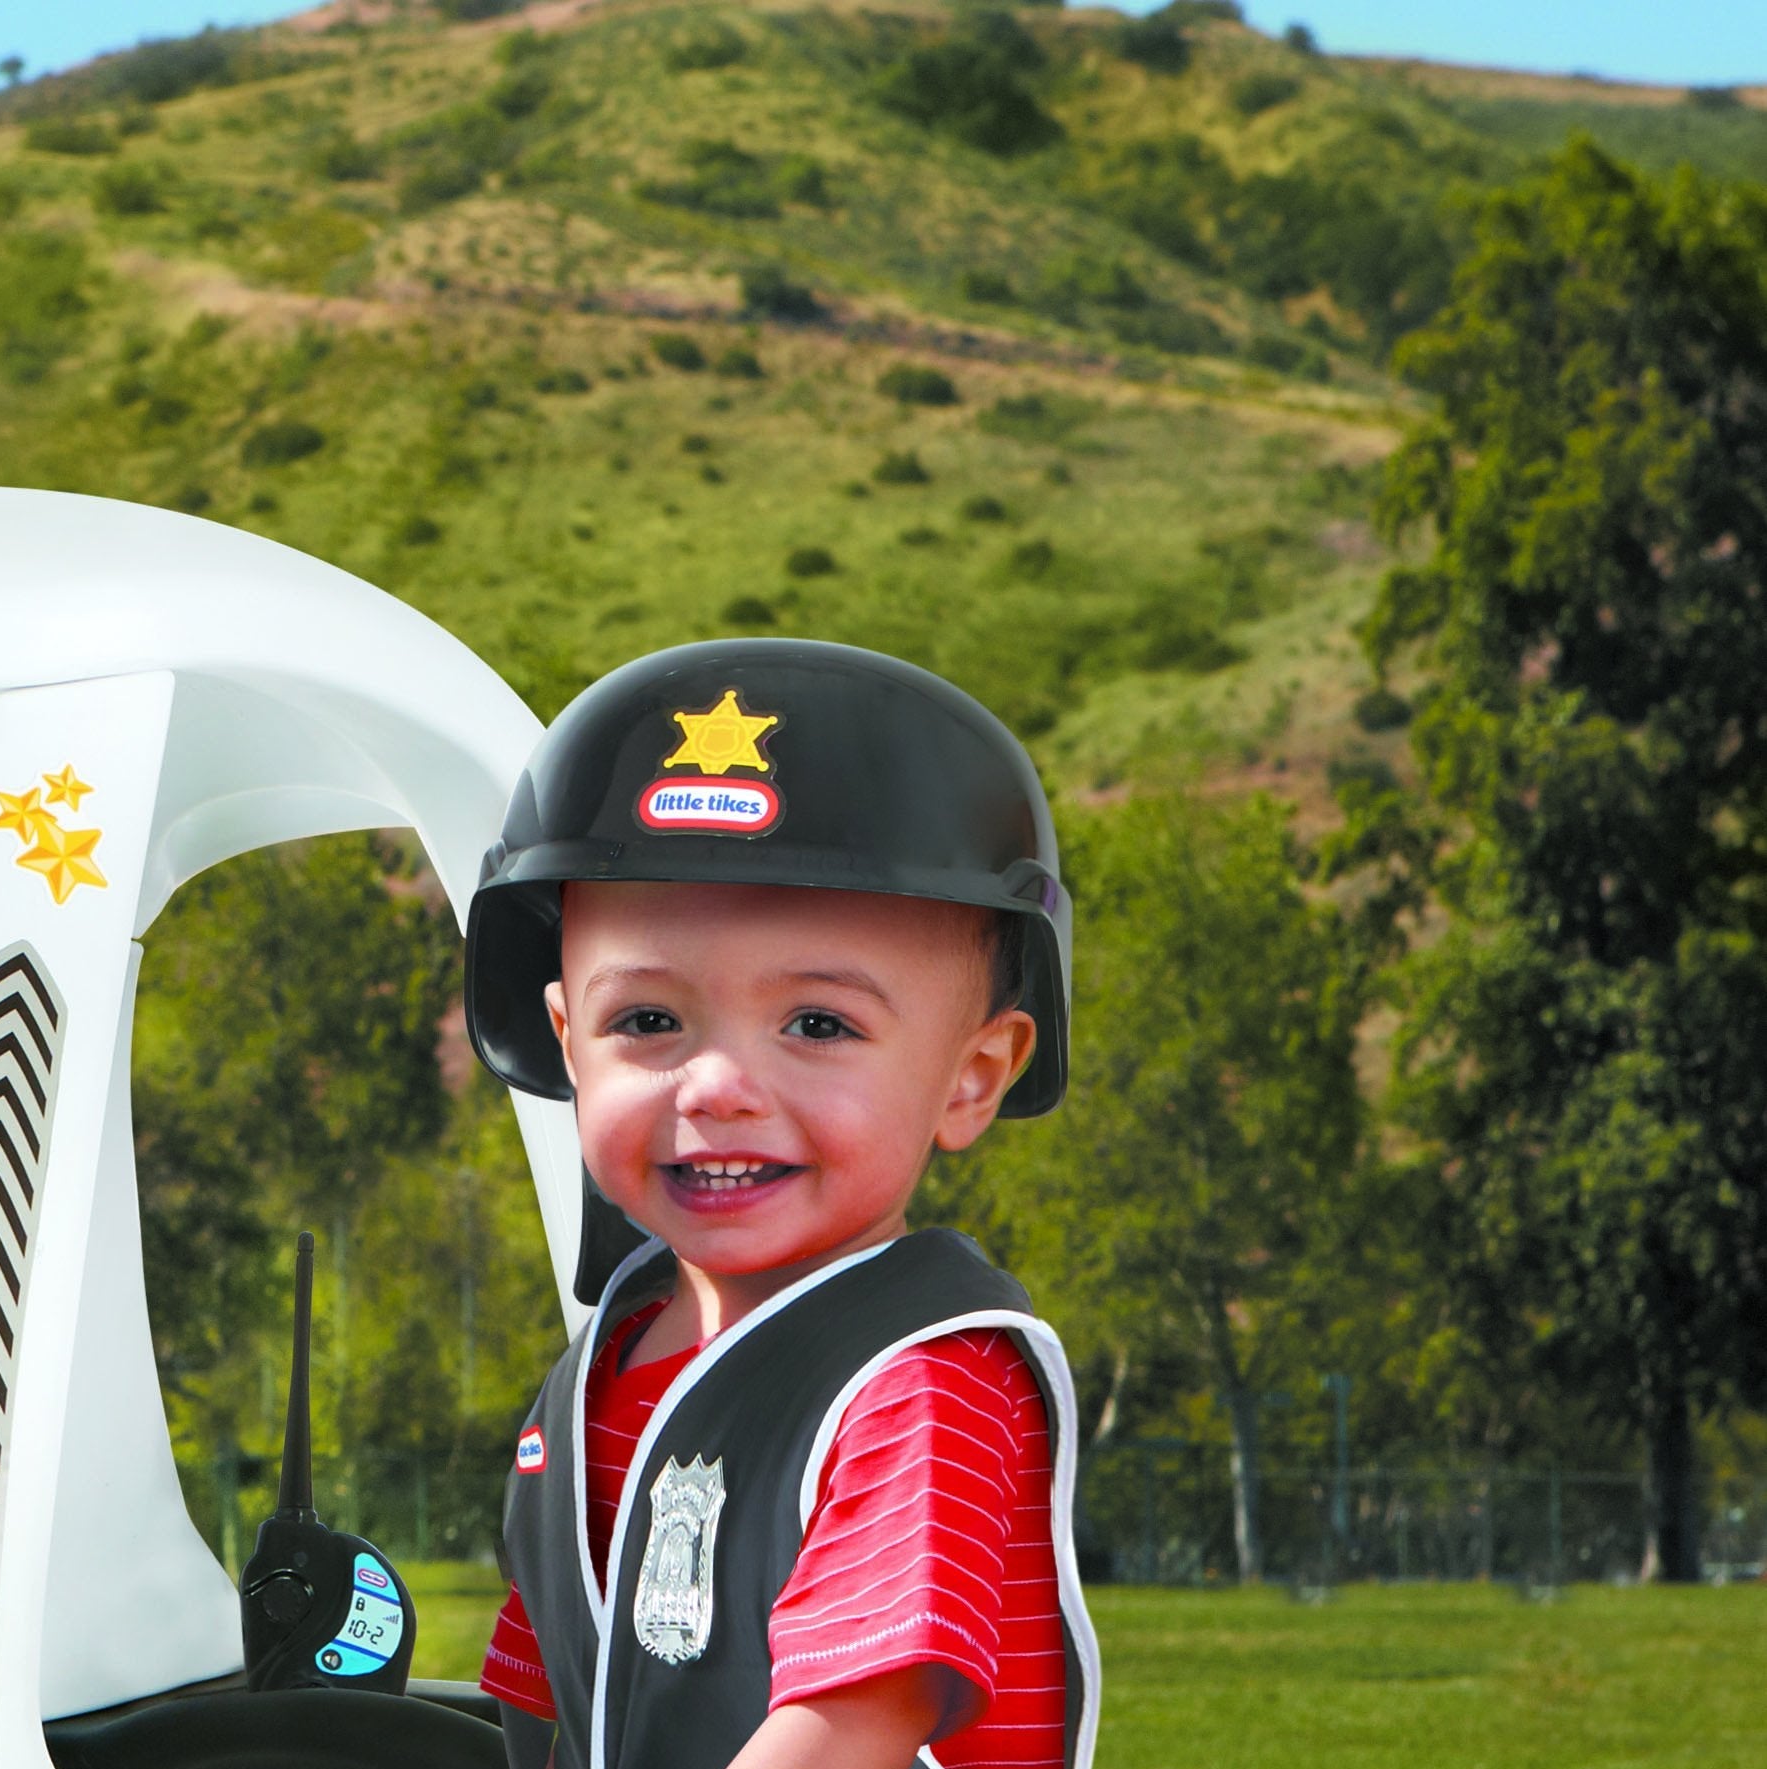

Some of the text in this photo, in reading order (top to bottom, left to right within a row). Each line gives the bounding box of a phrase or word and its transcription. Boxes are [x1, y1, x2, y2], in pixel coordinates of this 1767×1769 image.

[654, 793, 761, 815] little tikes
[347, 1619, 384, 1645] 10-2
